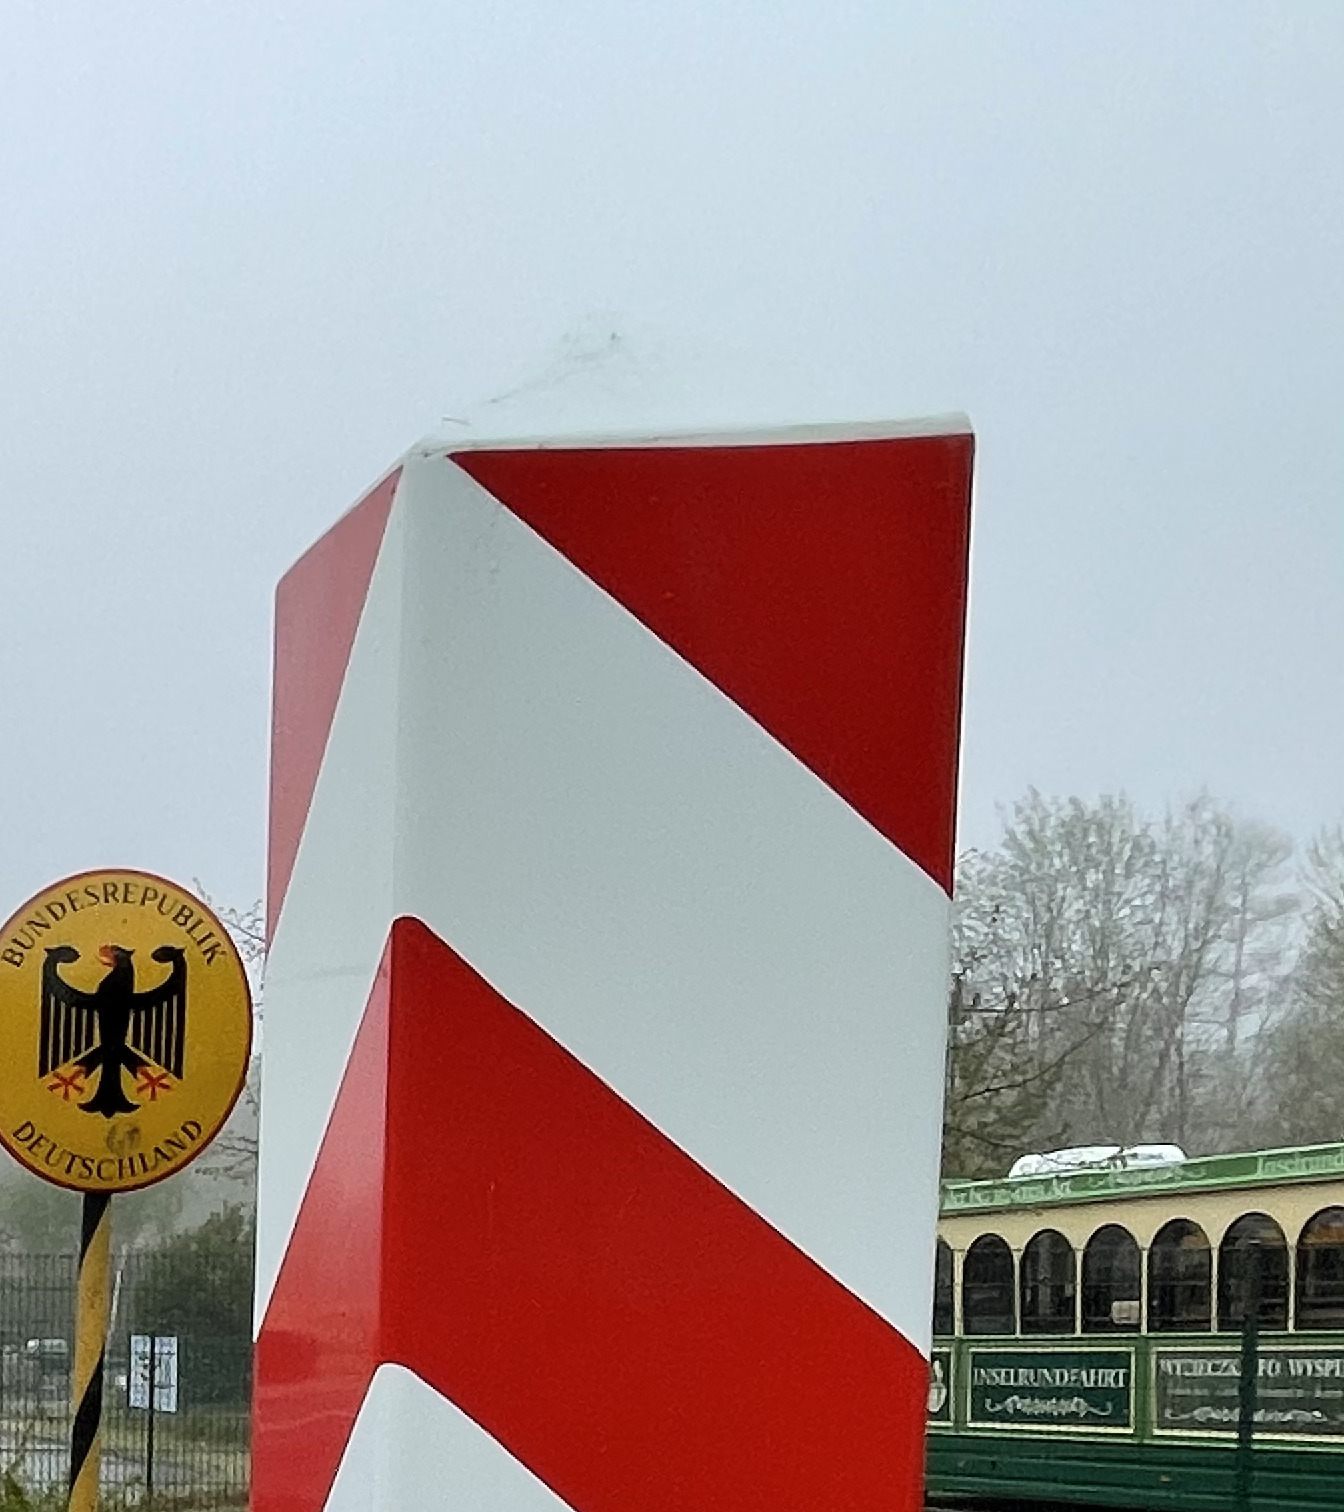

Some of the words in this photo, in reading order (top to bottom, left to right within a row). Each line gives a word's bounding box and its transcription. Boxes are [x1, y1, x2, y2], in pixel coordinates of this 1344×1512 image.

[0, 882, 227, 968] BUNDESREPUBLIK
[12, 1119, 203, 1181] DEUTSCHLAND
[973, 1368, 1129, 1388] INSELRUNDFAHRT
